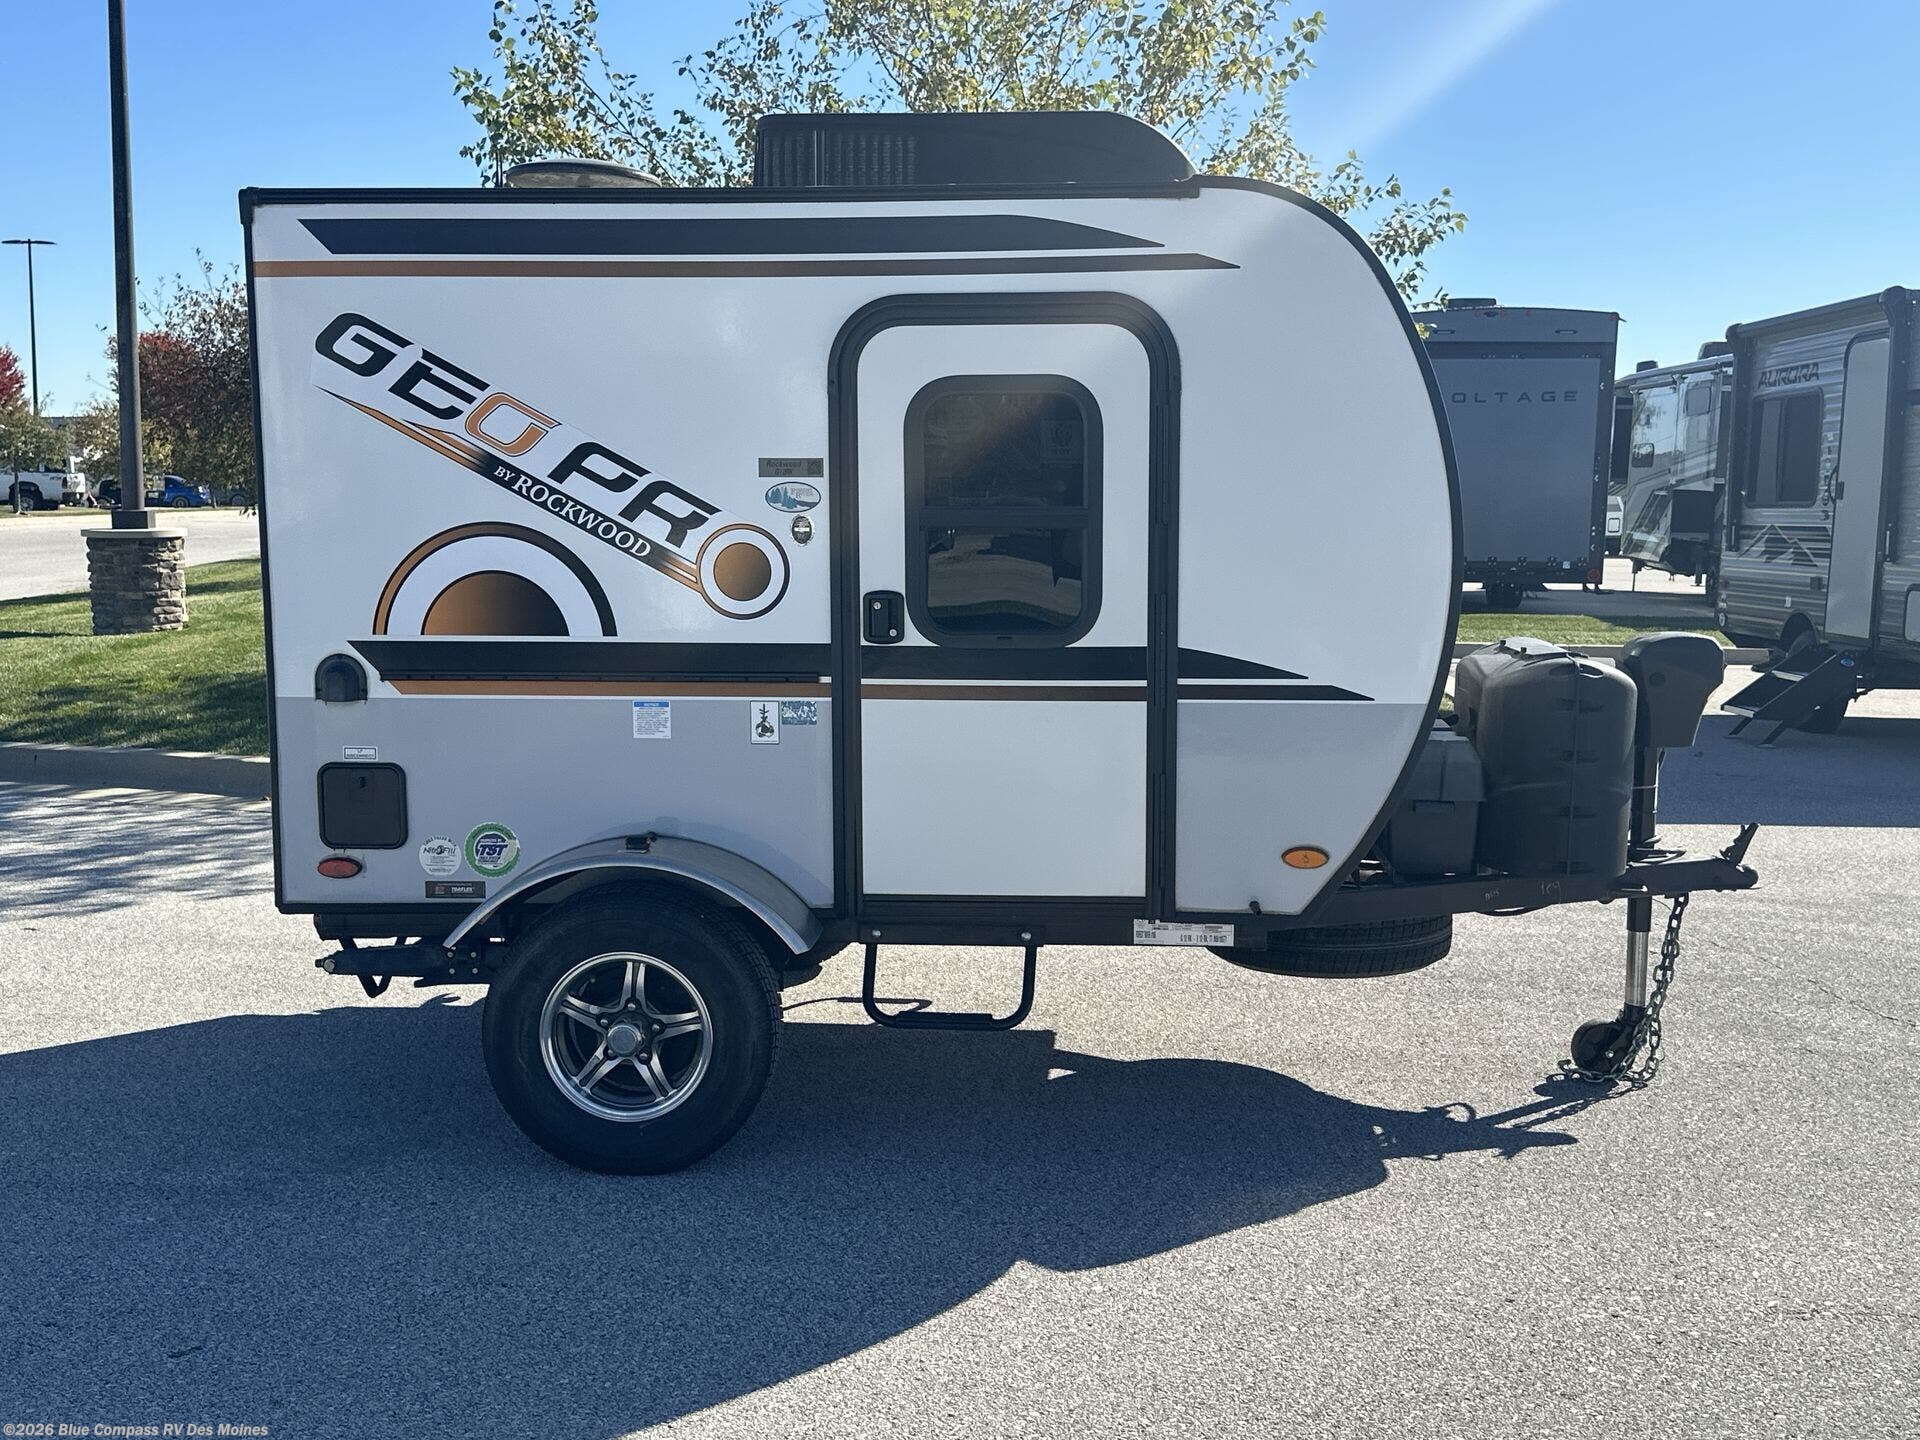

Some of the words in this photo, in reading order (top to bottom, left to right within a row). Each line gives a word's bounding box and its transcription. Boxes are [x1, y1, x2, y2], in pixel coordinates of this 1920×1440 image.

[315, 312, 562, 457] GEO
[1757, 362, 1819, 389] AURORA
[1451, 391, 1577, 403] OLTAGE
[494, 466, 515, 481] BY
[515, 474, 652, 558] ROCKWOOD
[479, 844, 508, 856] TST
